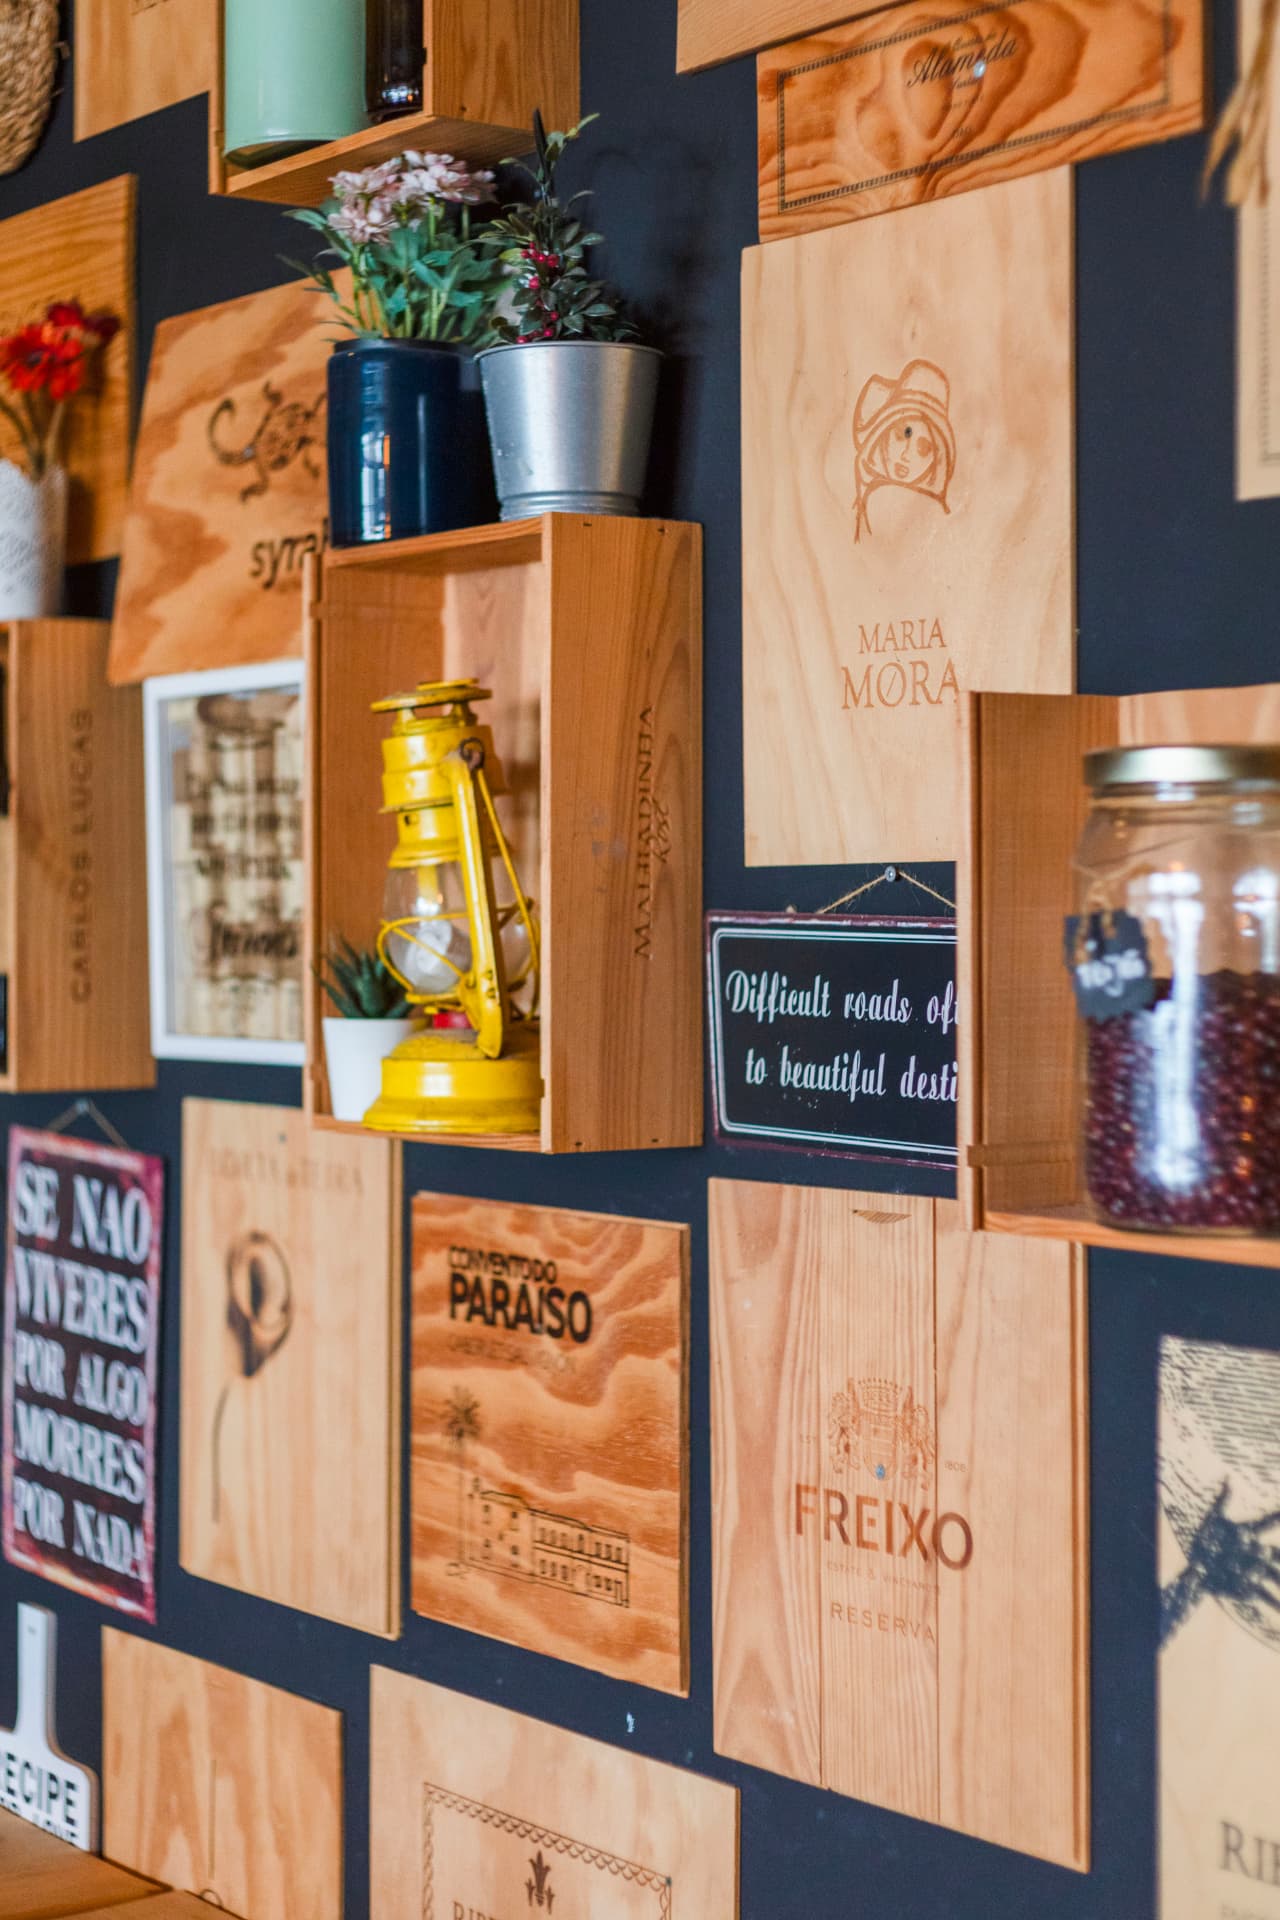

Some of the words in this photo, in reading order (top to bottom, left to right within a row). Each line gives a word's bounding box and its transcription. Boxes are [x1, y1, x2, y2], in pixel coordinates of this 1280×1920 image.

[858, 617, 947, 654] MARIA
[69, 707, 94, 836] LUCAS
[69, 850, 92, 1003] CARLOS
[726, 969, 831, 1024] Difficult
[844, 978, 913, 1023] roads
[745, 1048, 768, 1085] to
[780, 1045, 886, 1102] beautiful
[15, 1161, 60, 1241] SE
[14, 1245, 150, 1354] VIVERES
[16, 1330, 66, 1400] POR
[73, 1352, 147, 1427] ALGO
[15, 1400, 146, 1504] MORRES
[13, 1475, 66, 1549] POR
[73, 1500, 148, 1583] NADA
[795, 1483, 973, 1571] FREIXO
[831, 1602, 936, 1642] RESERVA
[1, 1751, 78, 1827] ECIPE
